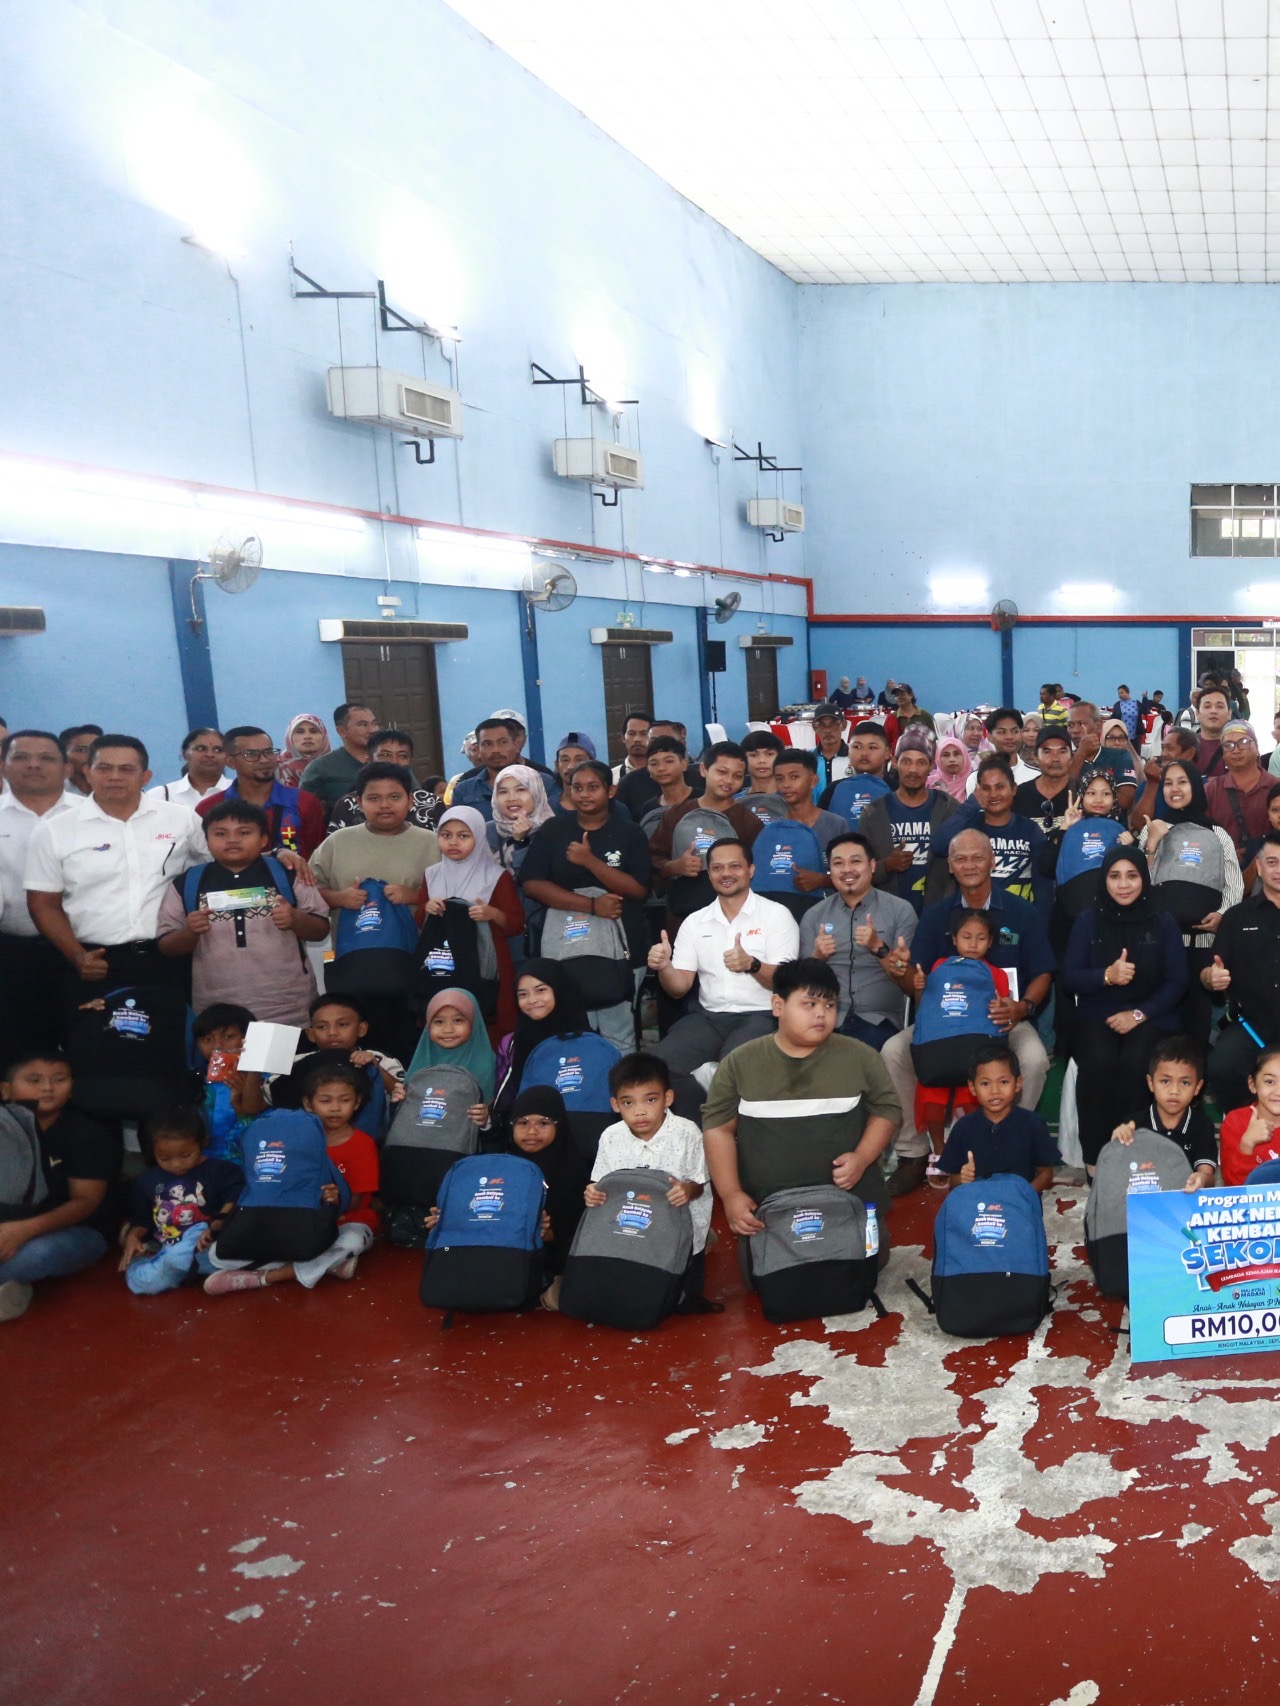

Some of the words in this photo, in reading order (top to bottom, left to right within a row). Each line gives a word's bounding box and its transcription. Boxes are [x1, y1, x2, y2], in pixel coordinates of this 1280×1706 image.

[896, 822, 930, 836] YAMA
[1198, 1193, 1263, 1208] Program
[1190, 1209, 1246, 1227] ANAK
[1220, 1272, 1245, 1281] LEMBAGA
